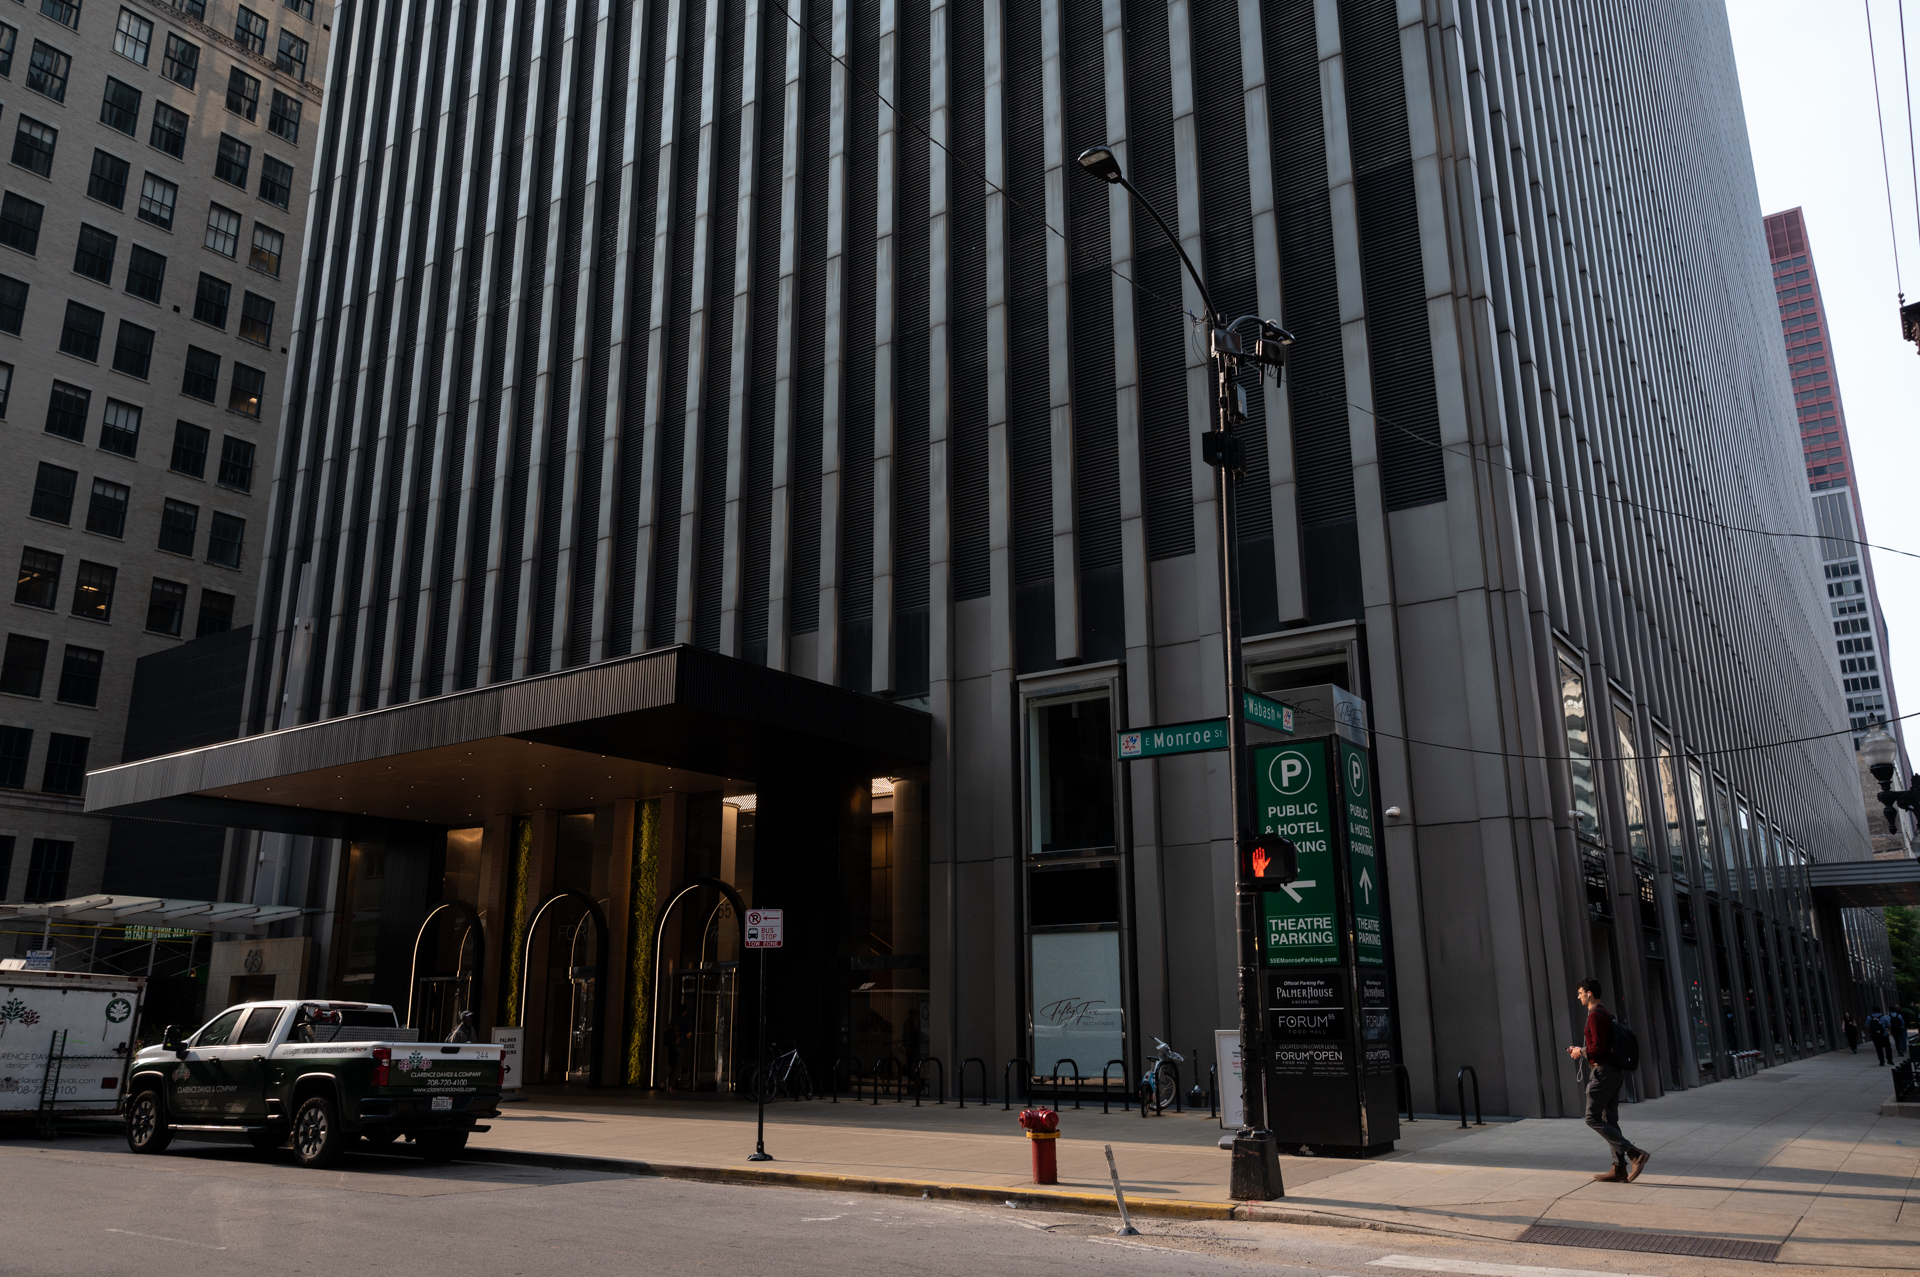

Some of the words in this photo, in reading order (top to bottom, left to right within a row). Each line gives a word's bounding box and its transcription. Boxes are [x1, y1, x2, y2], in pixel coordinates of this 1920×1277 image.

[1248, 696, 1276, 721] Wabash
[1146, 738, 1150, 747] E
[1154, 730, 1211, 748] Monroe
[1214, 728, 1222, 738] St
[1268, 802, 1318, 818] PUBLIC
[1350, 804, 1368, 820] PUBLIC
[1265, 826, 1274, 834] &
[1278, 821, 1324, 836] HOTEL
[1350, 822, 1354, 834] &
[1354, 824, 1372, 839] HOTEL
[1294, 840, 1326, 854] KING
[1350, 840, 1374, 857] PARKING
[1269, 917, 1332, 931] THEATRE
[1357, 918, 1380, 932] THEATRE
[558, 924, 597, 941] FORU
[1270, 932, 1333, 946] PARKING
[1358, 932, 1381, 946] PARKING
[1278, 1016, 1328, 1028] FORUM
[1275, 1051, 1309, 1060] FORUM
[1314, 1051, 1342, 1060] OPEN
